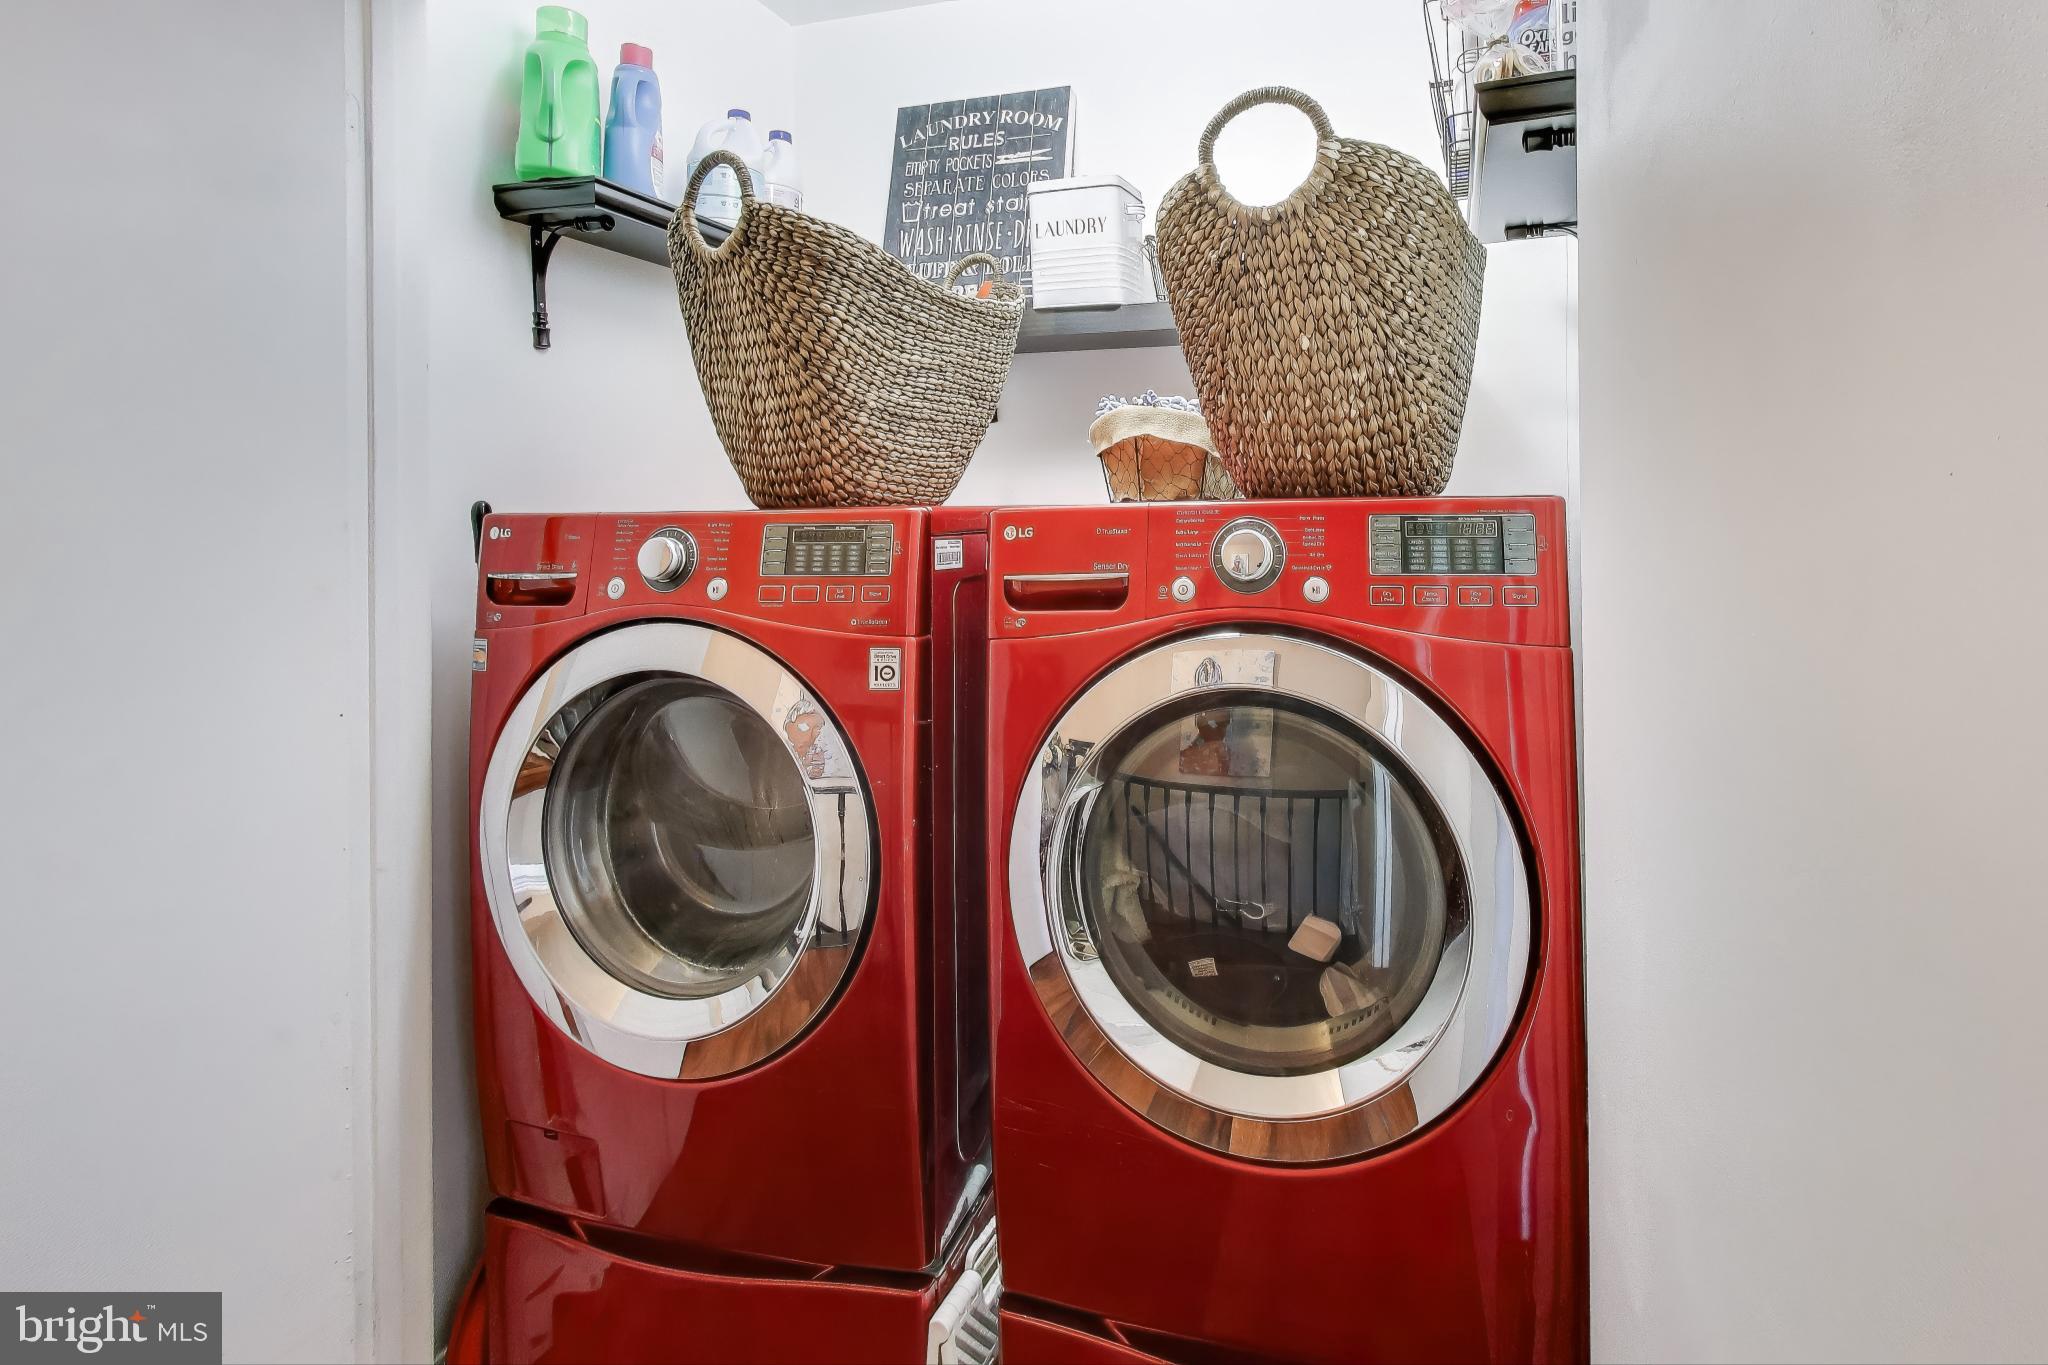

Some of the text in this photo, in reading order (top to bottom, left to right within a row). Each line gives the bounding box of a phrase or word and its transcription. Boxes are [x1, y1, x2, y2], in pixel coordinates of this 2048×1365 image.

[899, 109, 1063, 149] LAUNDRY ROOM
[948, 131, 1005, 151] RULES
[904, 153, 993, 177] EMPTY POCKETS
[903, 169, 1050, 198] SEPARATE COLORS
[923, 195, 1030, 220] treat stai
[899, 226, 945, 258] WASH
[954, 221, 1004, 254] RINSE
[1035, 215, 1109, 240] LAUNDRY
[500, 528, 512, 538] LG
[1018, 527, 1034, 538] LG
[1093, 562, 1129, 571] Sensor Dry
[874, 665, 896, 682] 10
